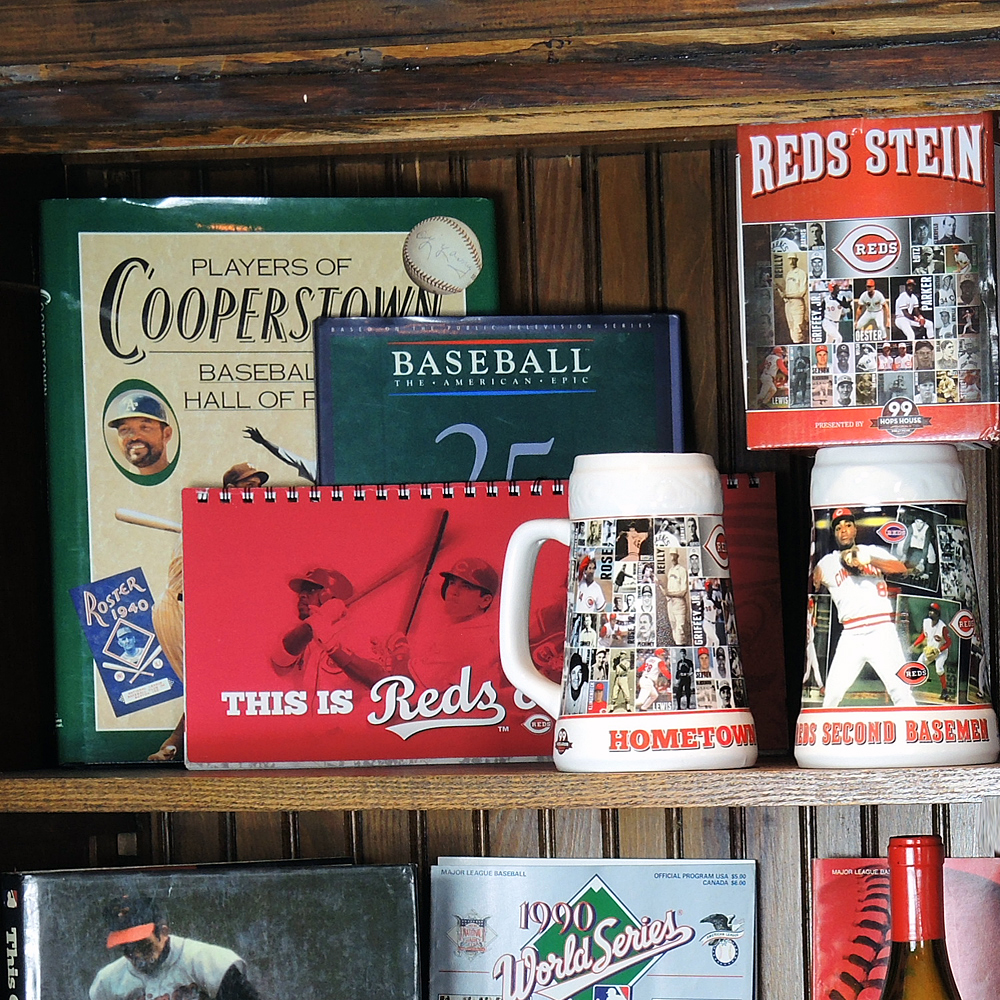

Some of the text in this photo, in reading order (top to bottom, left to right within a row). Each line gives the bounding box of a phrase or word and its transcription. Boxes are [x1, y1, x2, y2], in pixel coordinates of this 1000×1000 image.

[750, 130, 850, 198] REDS
[865, 125, 986, 187] STEIN
[855, 242, 898, 256] REDS
[191, 257, 352, 277] PLAYERS OF
[921, 276, 933, 311] PARKER
[508, 322, 653, 331] TELEVISION SERIES
[855, 329, 883, 341] OESTER
[391, 347, 592, 376] BASEBALL
[394, 376, 590, 388] THE AMERICAN EPIC
[183, 391, 294, 409] HALL OF
[888, 401, 913, 417] 99
[815, 420, 864, 429] PRESENTED BY
[880, 416, 922, 425] HOPS HOUSE
[83, 576, 147, 627] ROSTER
[110, 598, 149, 621] 1940
[906, 669, 927, 678] REDS
[221, 690, 308, 717] THIS
[317, 689, 354, 715] IS
[367, 665, 506, 741] Reds
[608, 723, 756, 752] HOMETOWN
[822, 720, 896, 746] SECOND
[441, 868, 465, 876] MAJOR
[519, 900, 597, 935] 1990
[592, 908, 697, 974] Series
[6, 927, 17, 993] This
